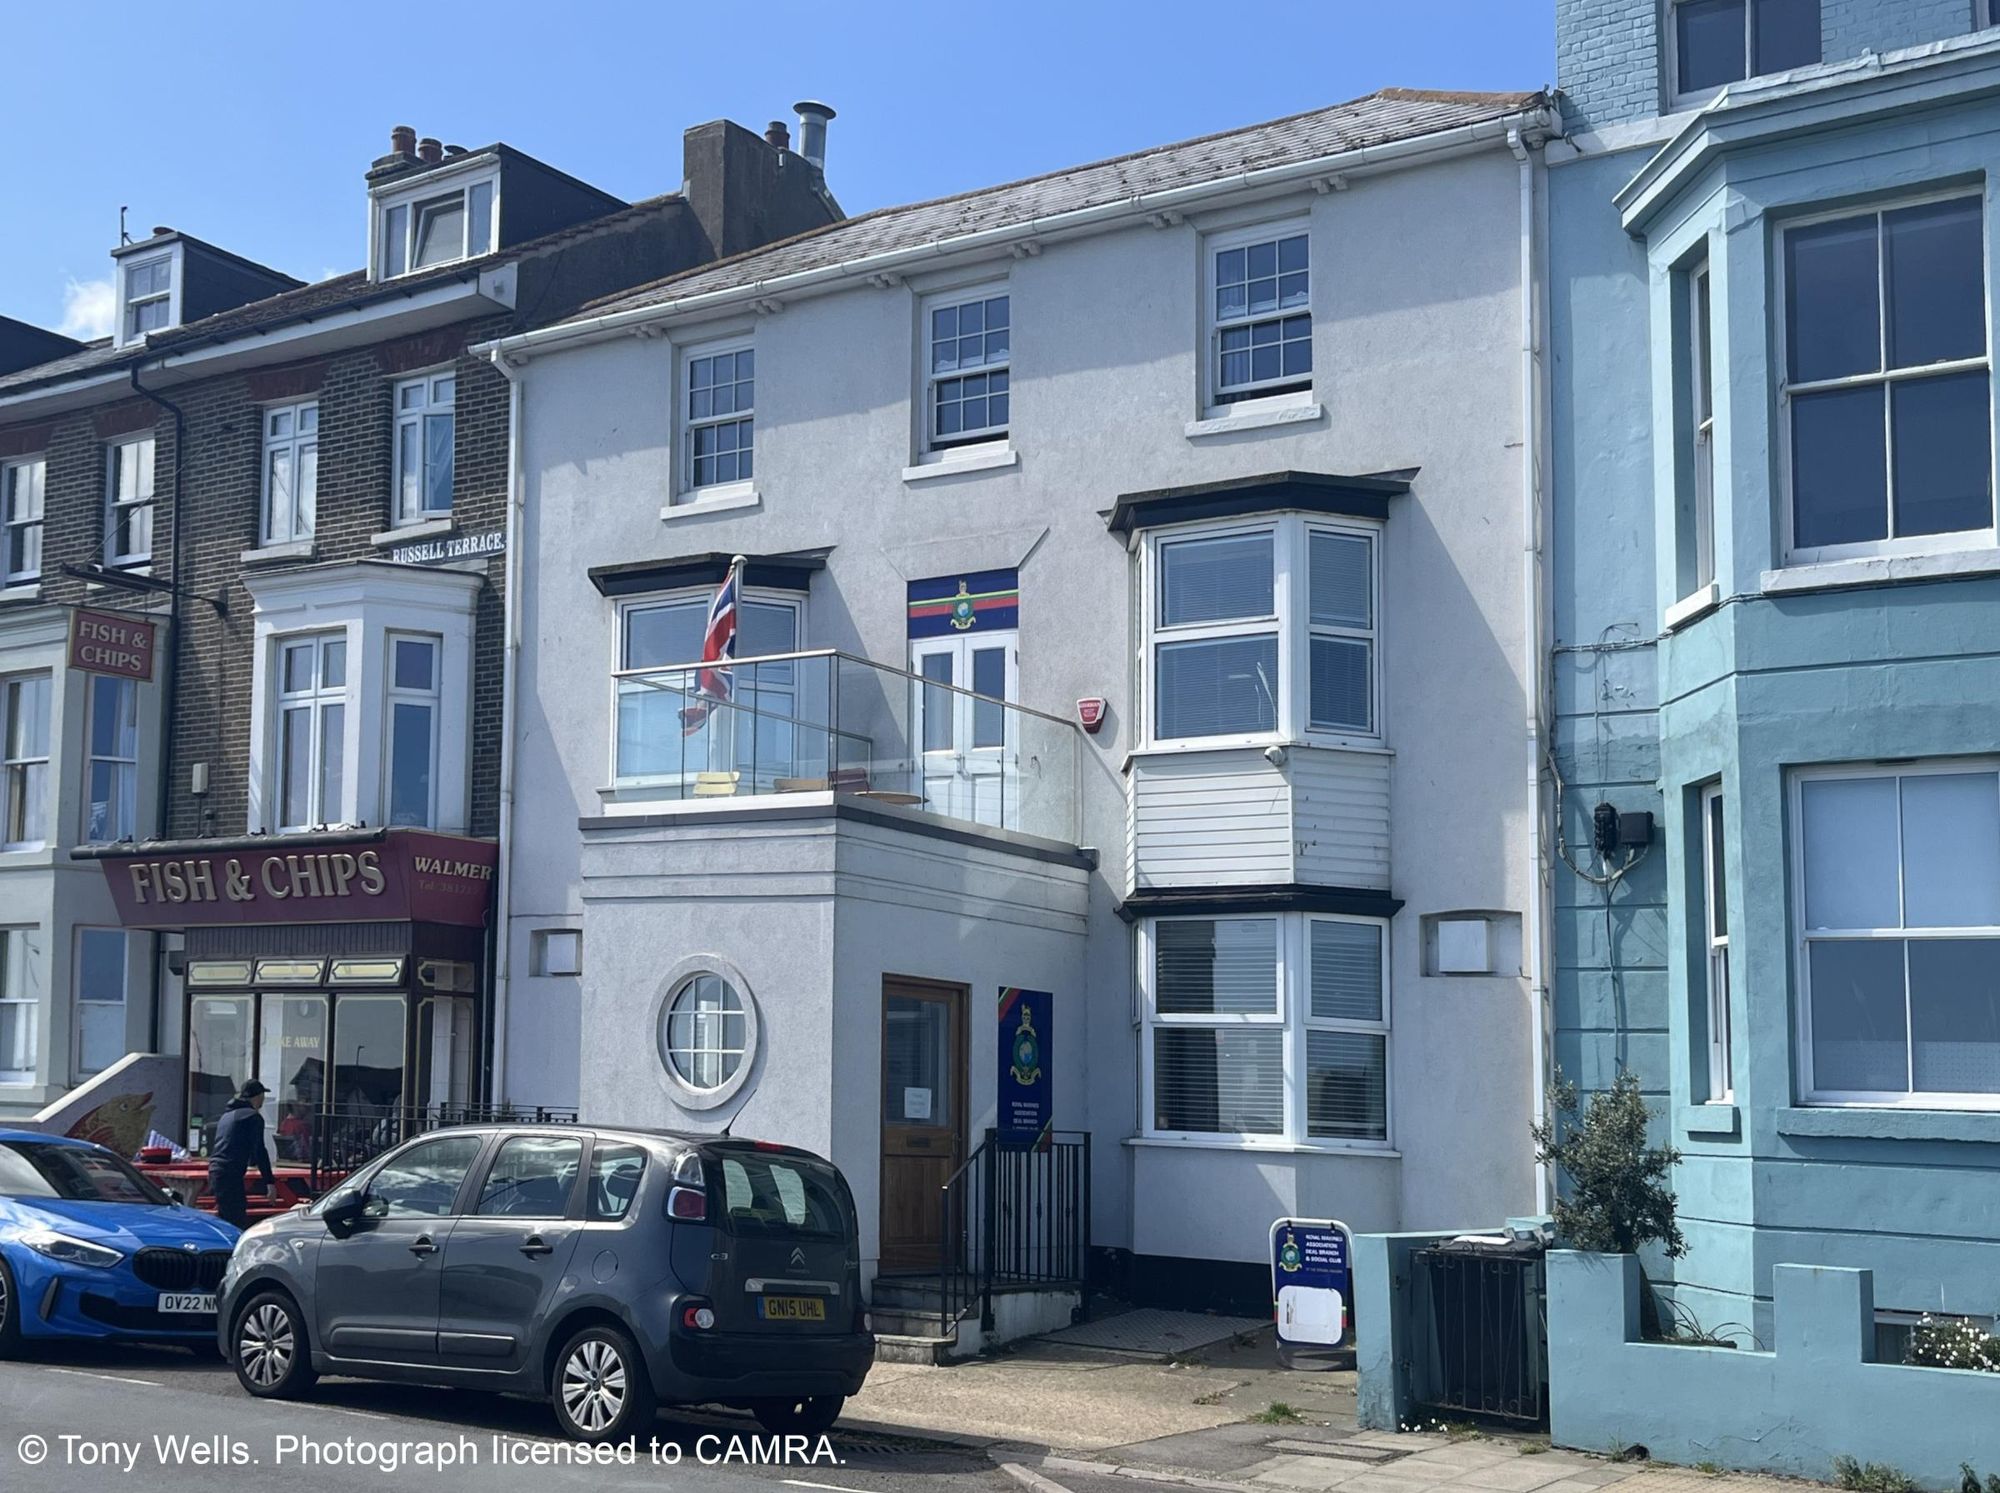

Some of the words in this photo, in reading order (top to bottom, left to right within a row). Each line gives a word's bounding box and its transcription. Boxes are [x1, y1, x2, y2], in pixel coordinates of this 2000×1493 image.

[393, 542, 445, 563] RUSSELL
[446, 532, 505, 557] TERRACE.
[79, 621, 127, 645] FISH
[131, 631, 147, 649] &
[80, 645, 142, 671] CHIPS
[128, 860, 217, 904] FISH
[224, 858, 255, 901] &
[261, 850, 386, 899] CHIPS
[414, 856, 493, 880] WALMER
[293, 1036, 320, 1048] AWAY
[165, 1296, 200, 1310] OV22
[768, 1299, 797, 1317] GN15
[799, 1300, 822, 1317] UHL
